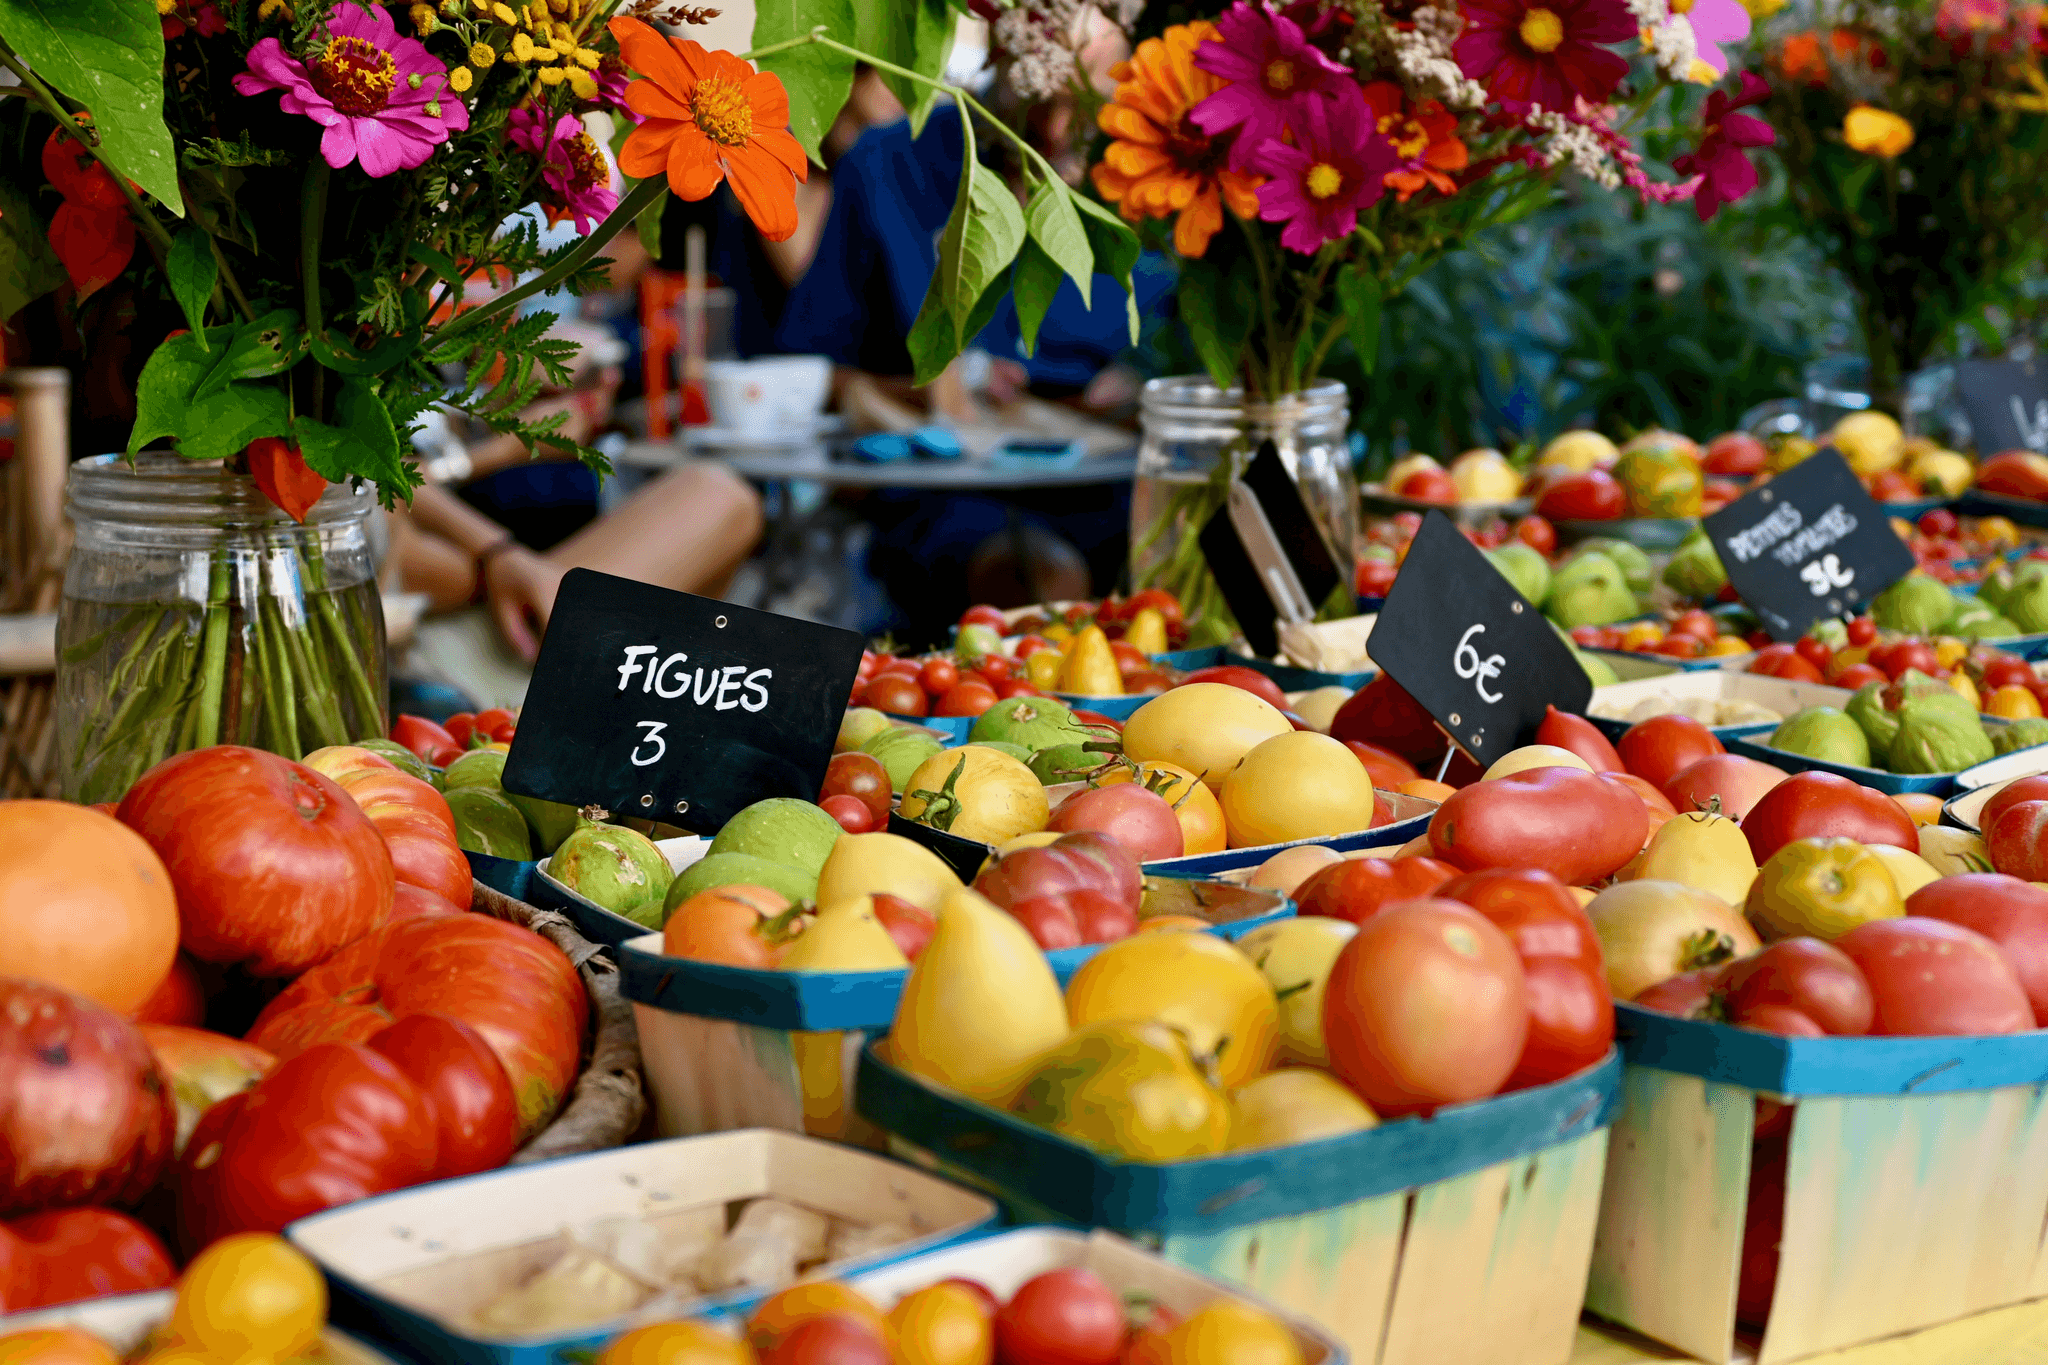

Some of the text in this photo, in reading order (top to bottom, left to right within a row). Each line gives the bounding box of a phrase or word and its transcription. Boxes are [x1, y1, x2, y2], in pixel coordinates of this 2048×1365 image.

[617, 645, 772, 712] FIGUES
[1454, 623, 1506, 704] 6€
[630, 720, 668, 766] 3
